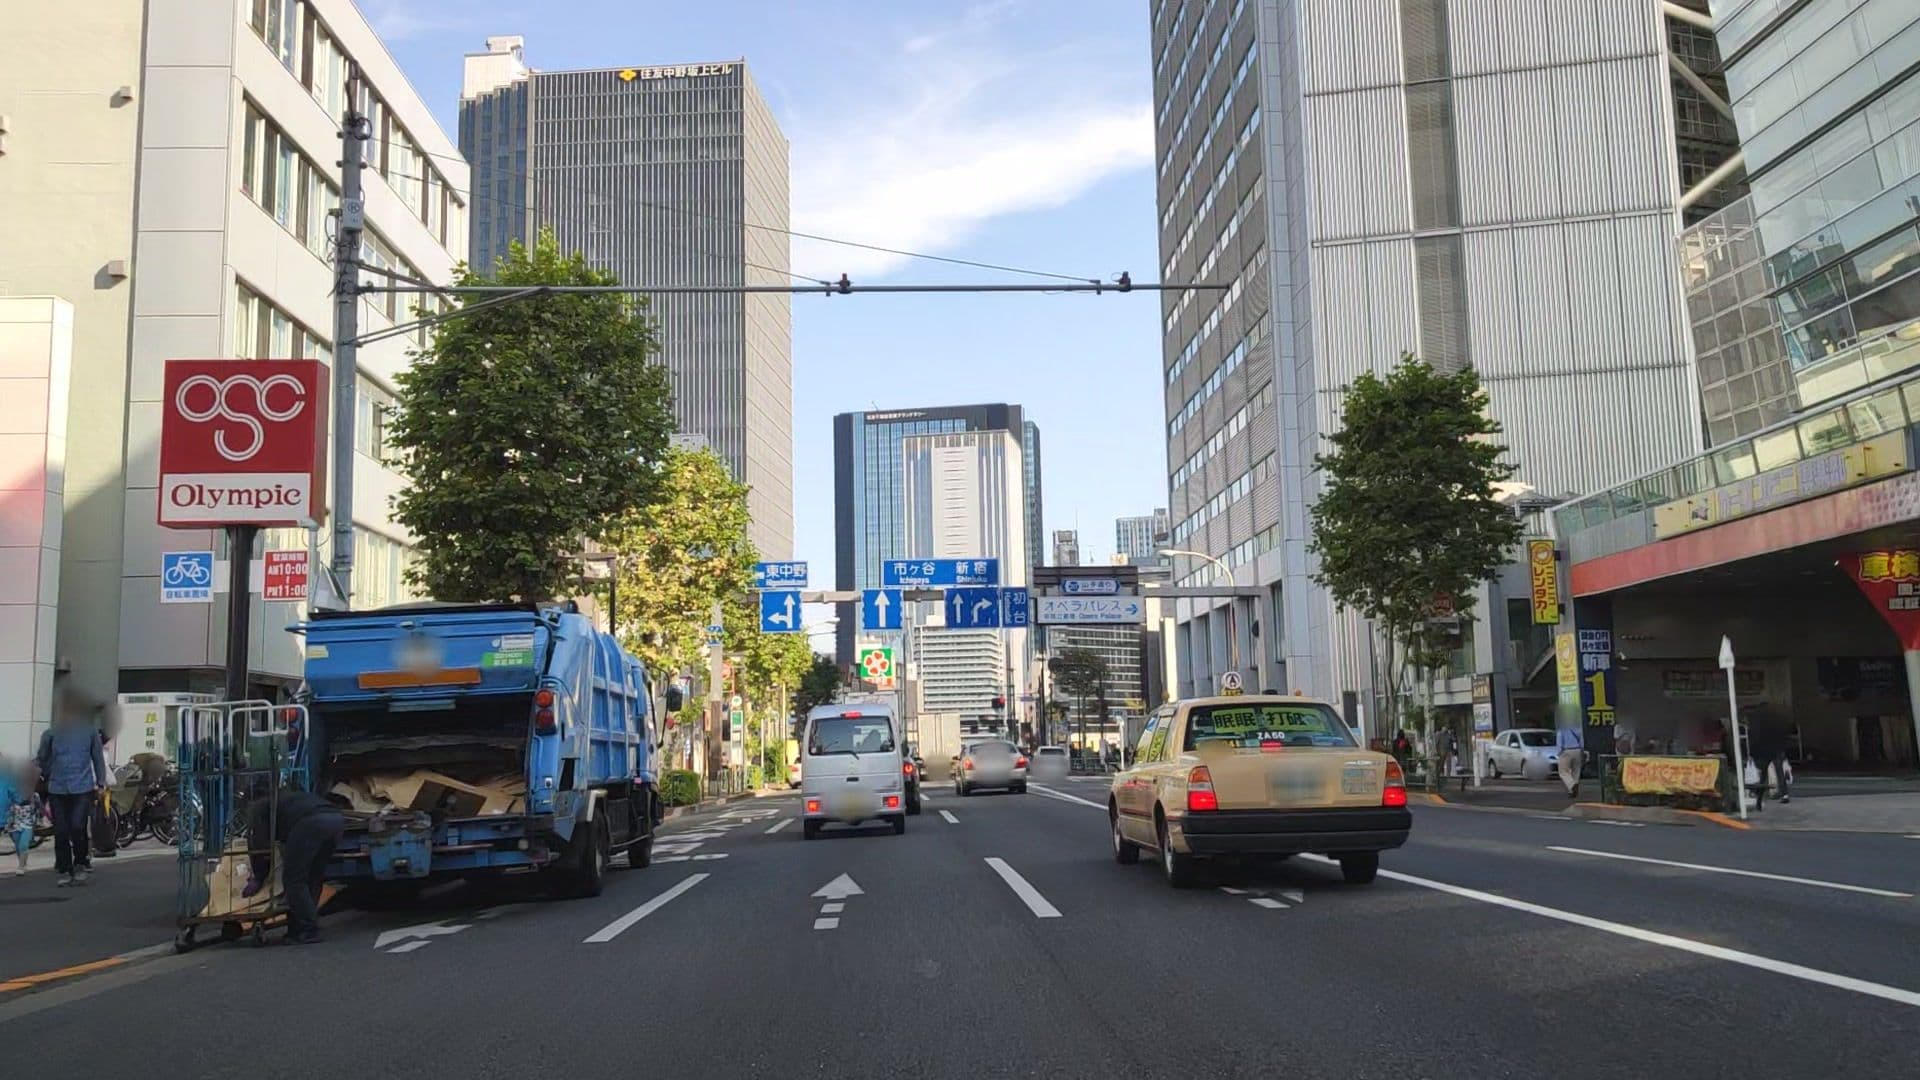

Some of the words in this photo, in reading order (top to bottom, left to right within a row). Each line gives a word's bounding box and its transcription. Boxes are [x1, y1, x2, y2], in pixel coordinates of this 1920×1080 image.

[640, 63, 733, 80] 住友中野坂上ビル
[170, 483, 303, 510] Olympic
[766, 564, 807, 579] 東中野
[893, 562, 936, 576] 市ヶ谷
[955, 561, 989, 576] 新宿
[1533, 566, 1548, 620] レンタカー
[1546, 565, 1556, 606] ニコニコ
[1012, 591, 1027, 625] 初台
[1044, 600, 1121, 612] オペラパレス
[1585, 671, 1614, 711] 1
[1588, 711, 1616, 727] 万円
